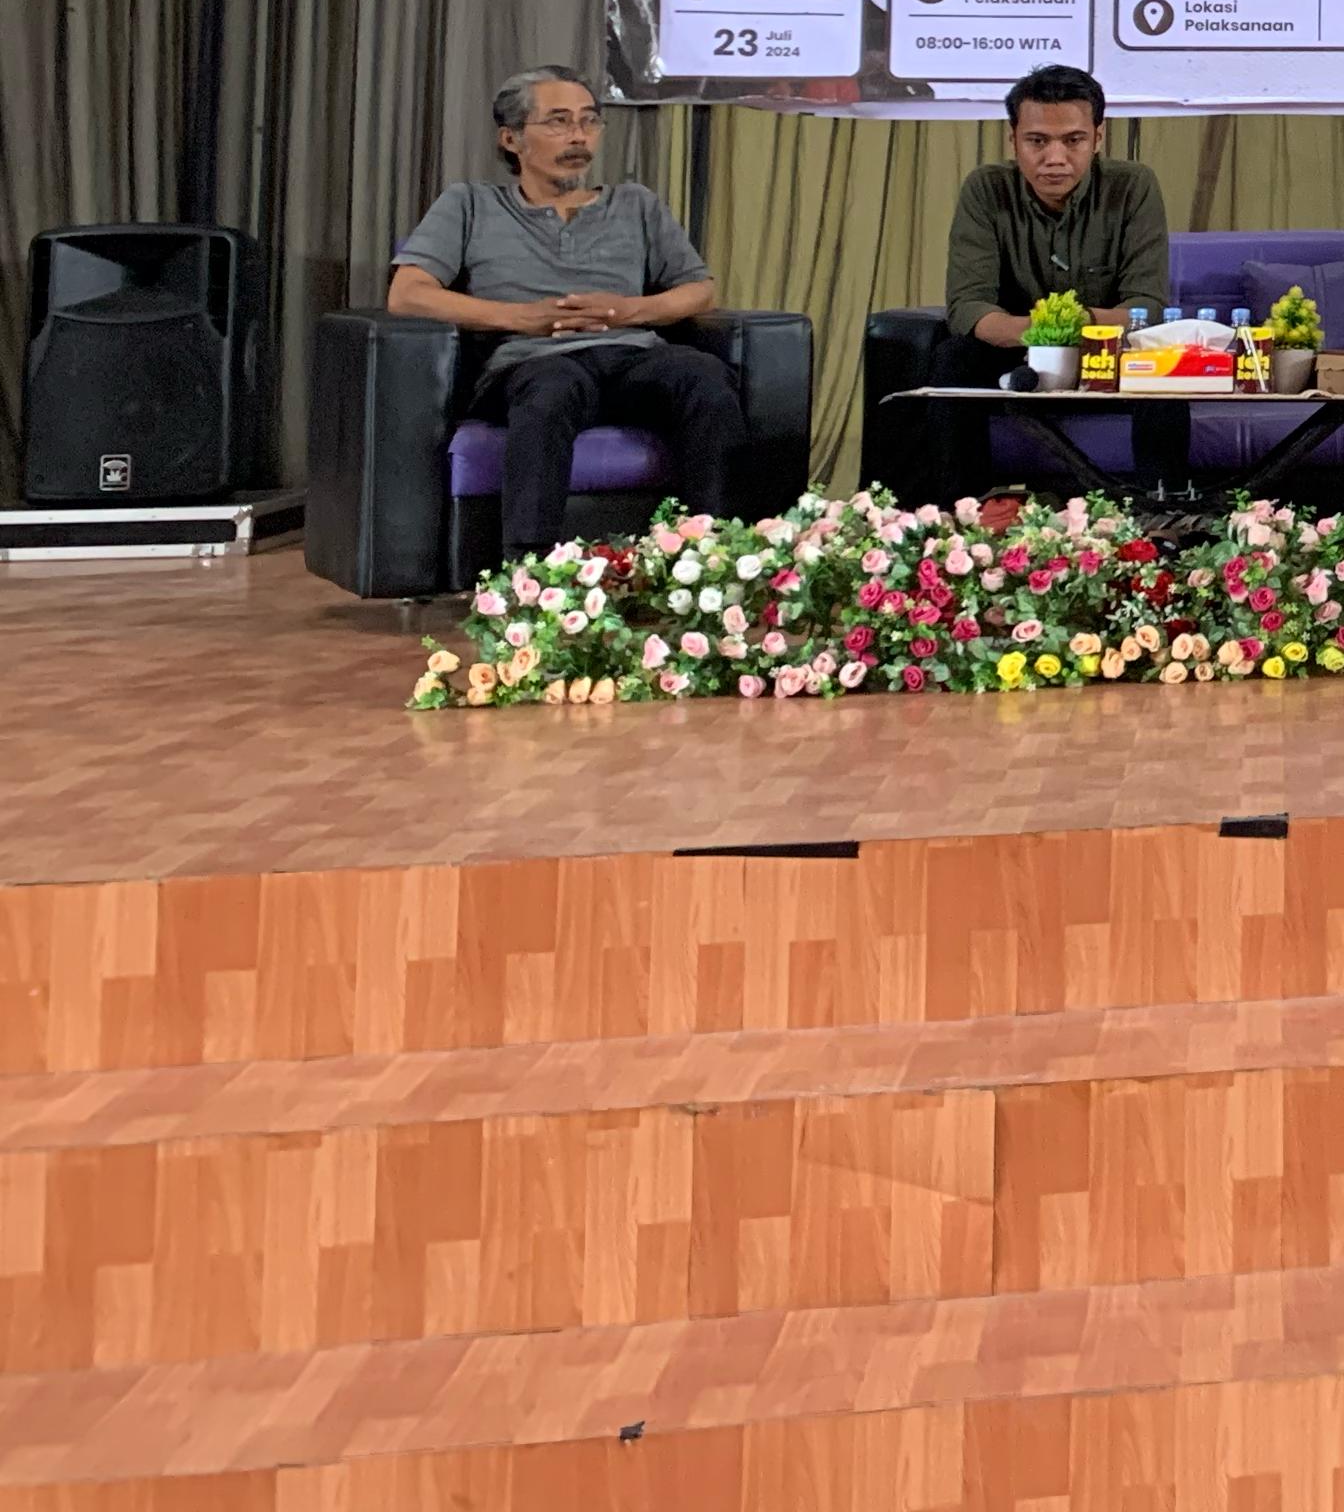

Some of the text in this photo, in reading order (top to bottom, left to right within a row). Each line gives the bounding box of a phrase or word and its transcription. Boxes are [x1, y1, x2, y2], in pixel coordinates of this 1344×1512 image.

[1185, 0, 1238, 14] Lokasi
[1185, 19, 1294, 33] Pelaksanaan
[713, 29, 759, 57] 23
[765, 30, 792, 42] Juli
[1019, 37, 1062, 52] WITA
[765, 46, 801, 58] 2024
[1082, 348, 1115, 369] teh
